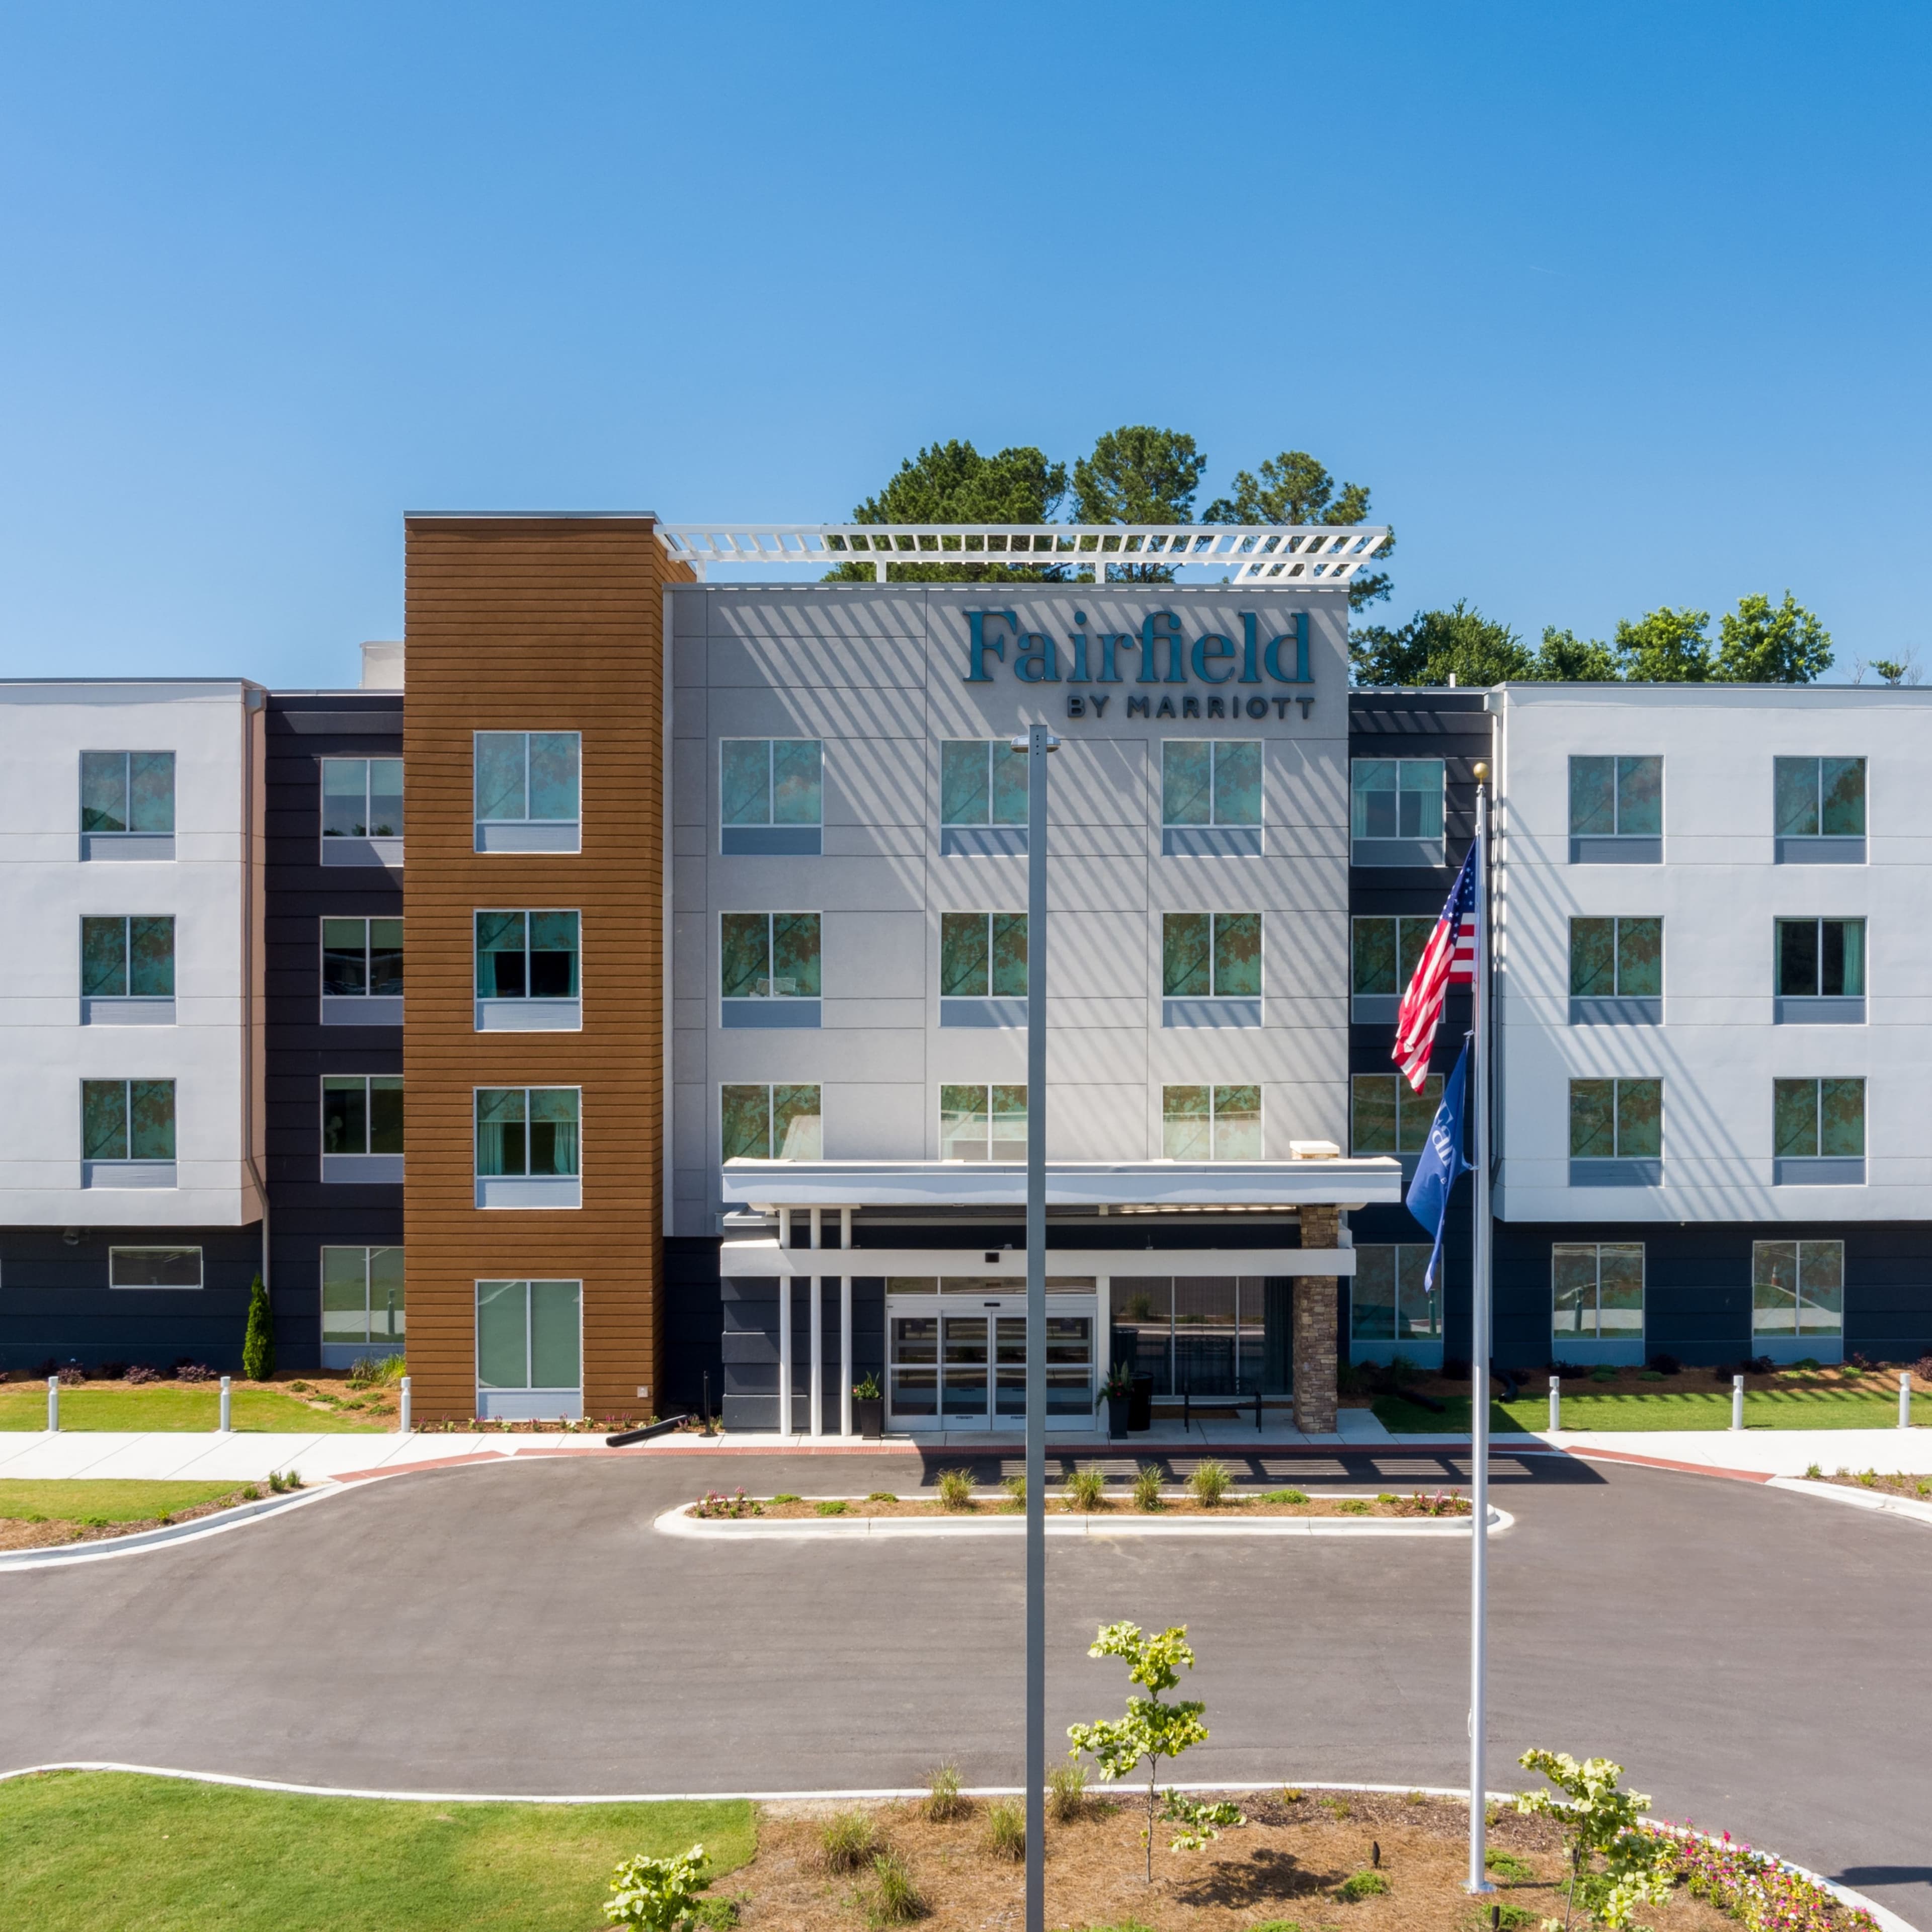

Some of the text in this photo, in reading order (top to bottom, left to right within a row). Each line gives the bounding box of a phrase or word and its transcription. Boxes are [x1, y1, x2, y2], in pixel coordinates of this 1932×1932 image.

[962, 610, 1315, 684] Fairfield
[1067, 695, 1315, 719] BY MARRIOTT
